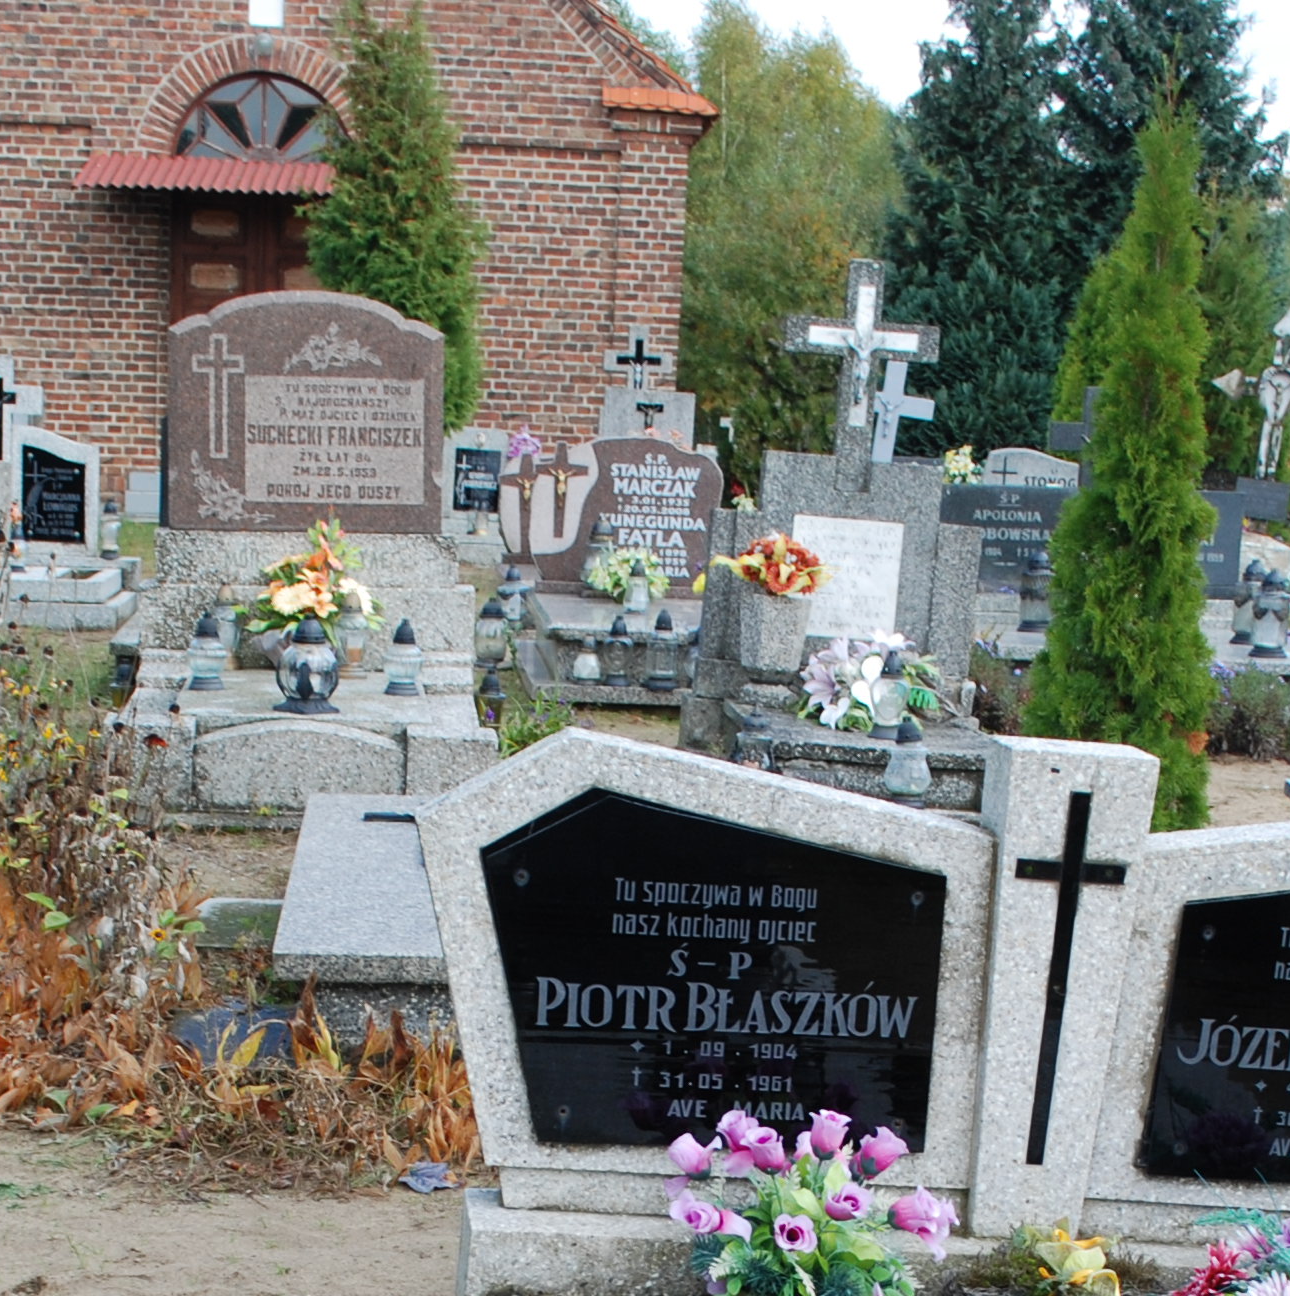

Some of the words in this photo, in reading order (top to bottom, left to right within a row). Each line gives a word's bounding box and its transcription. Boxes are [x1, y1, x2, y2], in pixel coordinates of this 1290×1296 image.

[246, 423, 322, 446] SUCHECKI
[327, 426, 422, 448] FRANCISZEK
[610, 462, 701, 482] STANISŁAW
[317, 484, 351, 499] JEGO
[358, 485, 401, 500] DUSZY
[613, 477, 697, 499] MARCZAK
[973, 508, 1043, 523] APOLONIA
[617, 528, 686, 548] FATLA
[614, 877, 637, 902] Tu
[642, 880, 742, 910] spoczywa
[748, 885, 764, 908] w
[770, 884, 818, 913] Bogu
[612, 912, 661, 937] nasz
[666, 912, 751, 945] kochany
[757, 918, 818, 945] ojciec
[534, 975, 678, 1034] PIOTR
[683, 981, 920, 1039] BŁASZKÓW
[666, 1099, 707, 1119] AVE
[732, 1101, 805, 1122] MARIA
